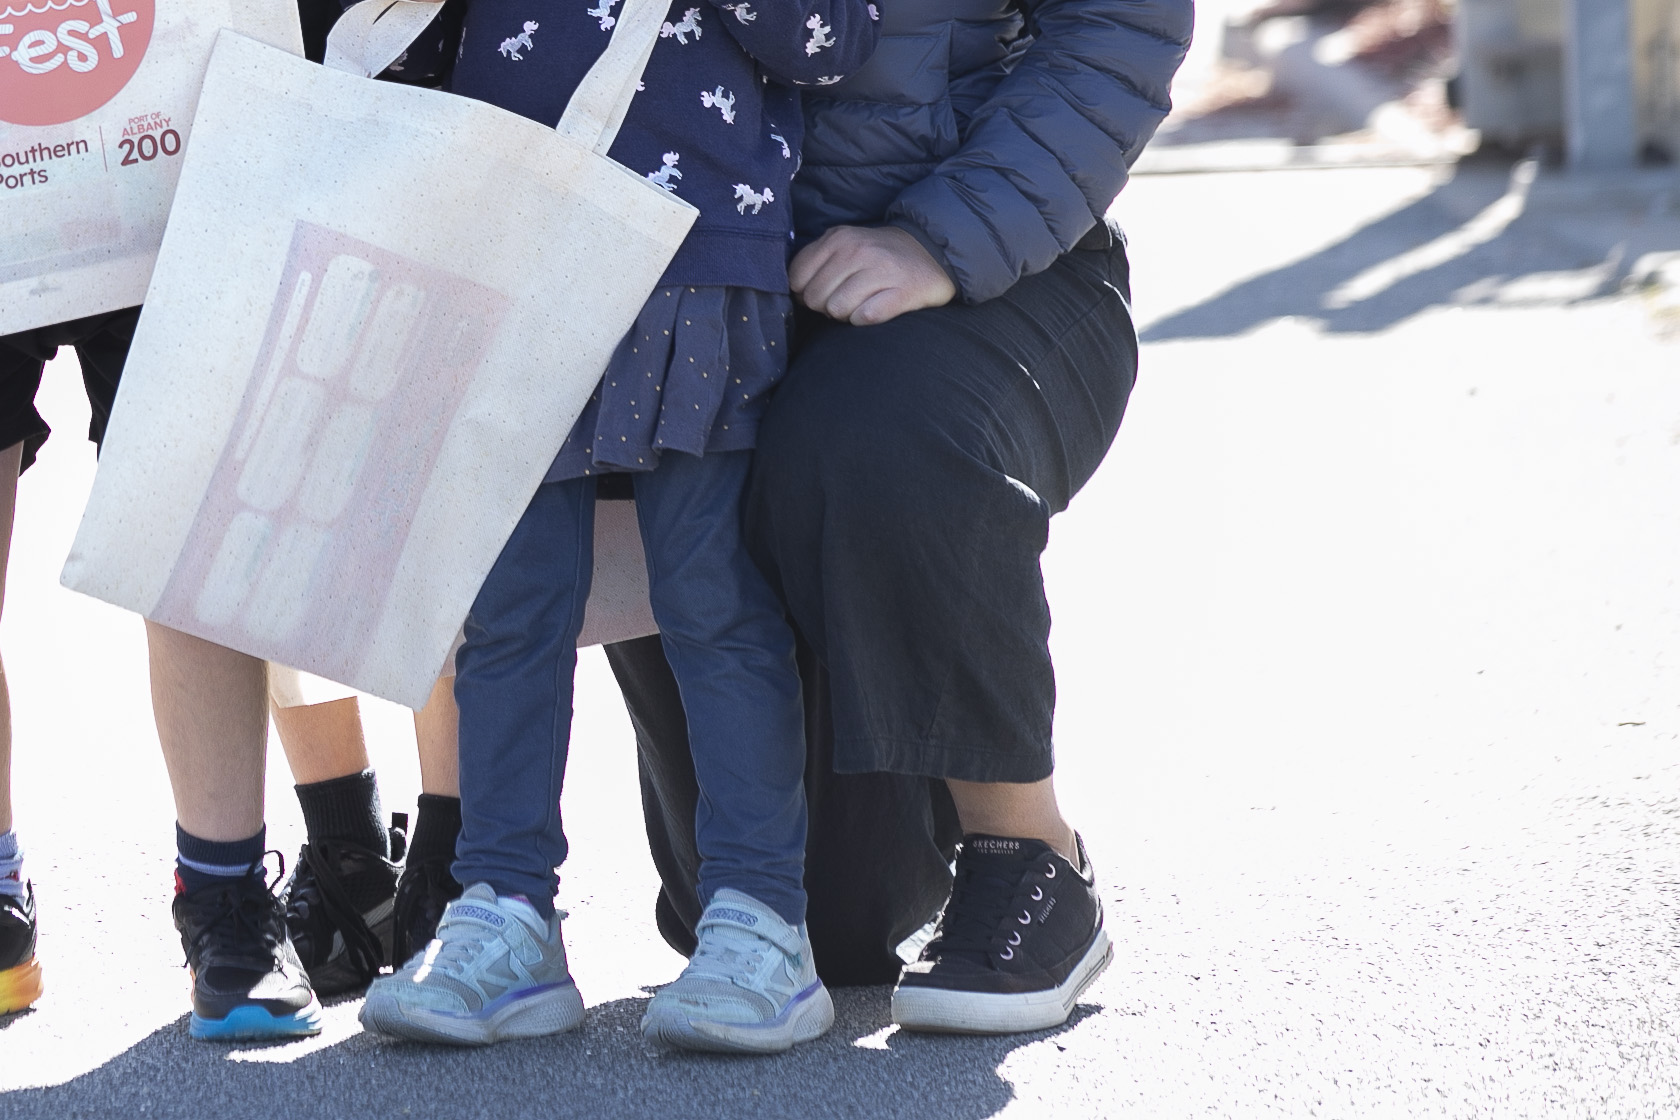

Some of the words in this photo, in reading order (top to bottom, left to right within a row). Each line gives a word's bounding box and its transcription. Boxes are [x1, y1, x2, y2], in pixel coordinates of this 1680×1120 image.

[121, 117, 172, 138] ALBANY
[128, 114, 149, 126] PORT
[150, 111, 162, 121] OF
[118, 128, 181, 167] 200
[972, 840, 1020, 850] SKECHERS
